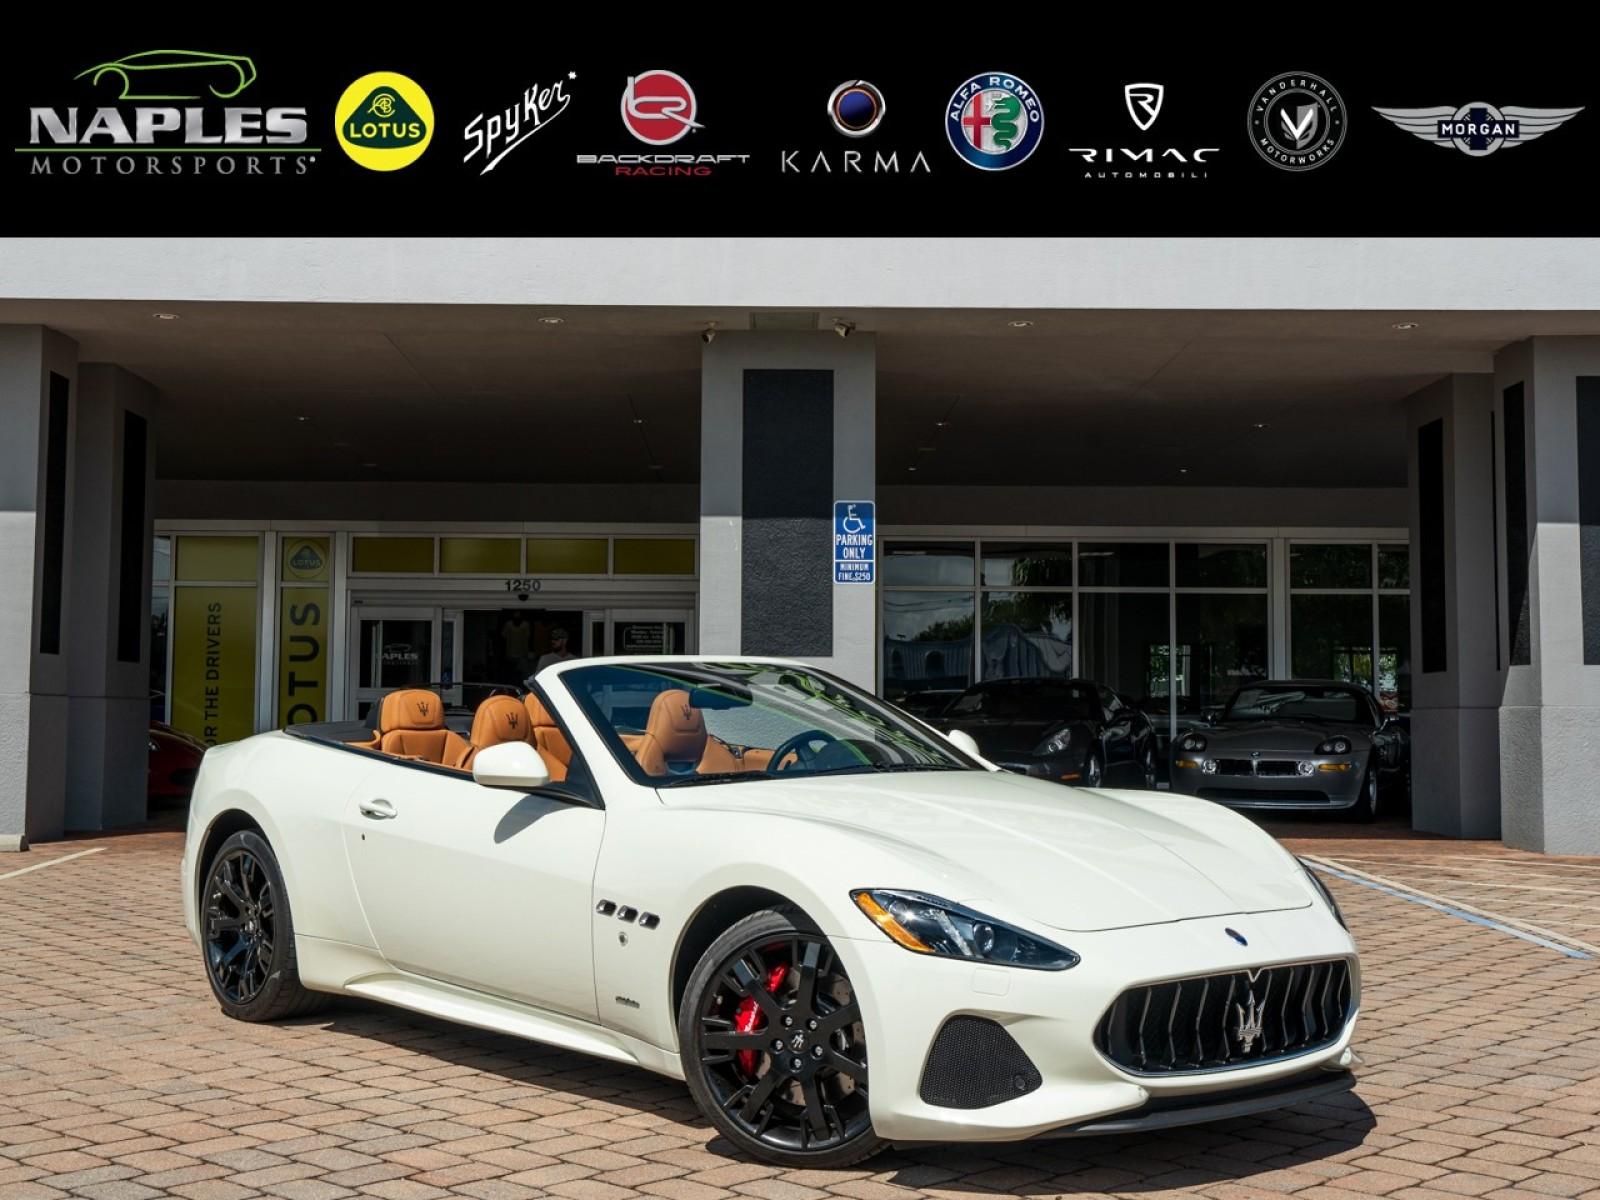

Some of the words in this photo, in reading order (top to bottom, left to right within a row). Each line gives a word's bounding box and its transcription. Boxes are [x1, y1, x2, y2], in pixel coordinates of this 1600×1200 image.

[835, 534, 873, 546] PARKING
[843, 547, 866, 559] ONLY
[293, 558, 321, 568] LOTUS
[505, 579, 541, 592] 1250
[205, 602, 222, 681] DRIVERS
[382, 652, 419, 661] APLES
[287, 602, 321, 726] OTUS
[204, 686, 219, 721] THE
[203, 726, 217, 747] OR
